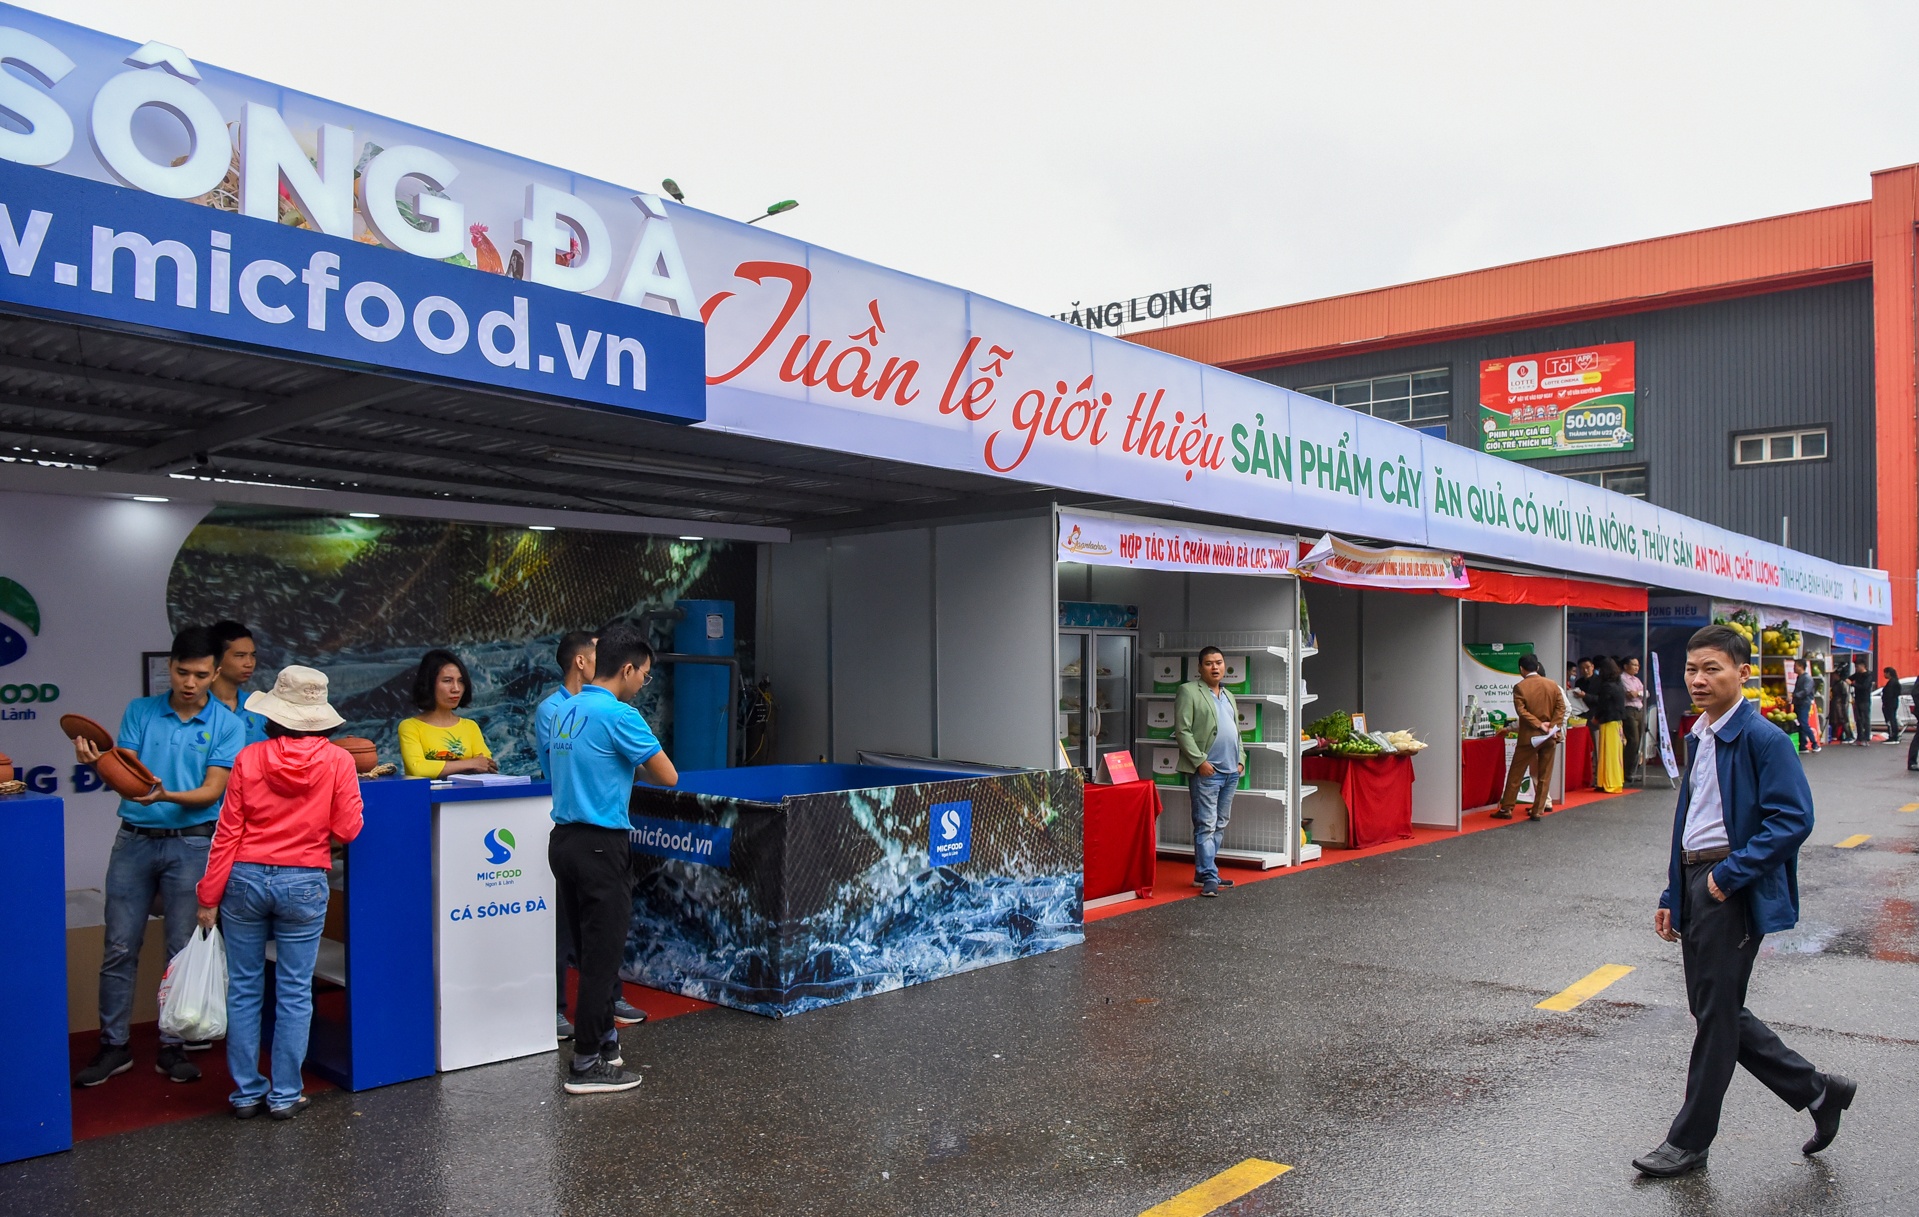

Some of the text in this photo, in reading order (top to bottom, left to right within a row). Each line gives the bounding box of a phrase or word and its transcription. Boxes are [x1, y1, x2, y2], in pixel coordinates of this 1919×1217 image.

[0, 25, 702, 322] SÔNG ĐÀ
[1130, 283, 1212, 323] LONG
[1510, 379, 1535, 387] LOTTE
[700, 260, 921, 408] Tuần
[937, 335, 1015, 421] lễ
[984, 374, 1114, 473] giới
[1120, 387, 1232, 483] thiệu
[1231, 412, 1293, 483] SẢN
[1299, 431, 1373, 500] PHẨM
[1378, 454, 1422, 509] CÂY
[1434, 465, 1463, 519] ĂN
[1467, 481, 1510, 529] QUẢ
[1512, 491, 1539, 535] CÓ
[1542, 500, 1572, 542] MÚI
[1575, 506, 1597, 547] VÀ
[1598, 511, 1641, 562] NÔNG,
[1641, 524, 1671, 562] THỦY
[1672, 531, 1694, 570] SẢN
[1695, 544, 1708, 573] AN
[1708, 545, 1735, 582] TOÀN,
[1735, 550, 1755, 582] CHẤT
[1754, 562, 1780, 592] LƯỢNG
[1488, 430, 1508, 439] PHIM
[1509, 429, 1525, 438] HAY
[1525, 425, 1539, 437] GIÁ
[1119, 532, 1290, 572] HỢP TÁC XÃ CHĂN NUÔI GÀ LẠC THỦY
[1, 707, 37, 721] Lành
[628, 825, 713, 856] micfood.vn
[936, 841, 964, 853] MICFOOD
[476, 868, 522, 881] MICFOOD
[449, 895, 547, 922] CÁ SÔNG ĐÀ
